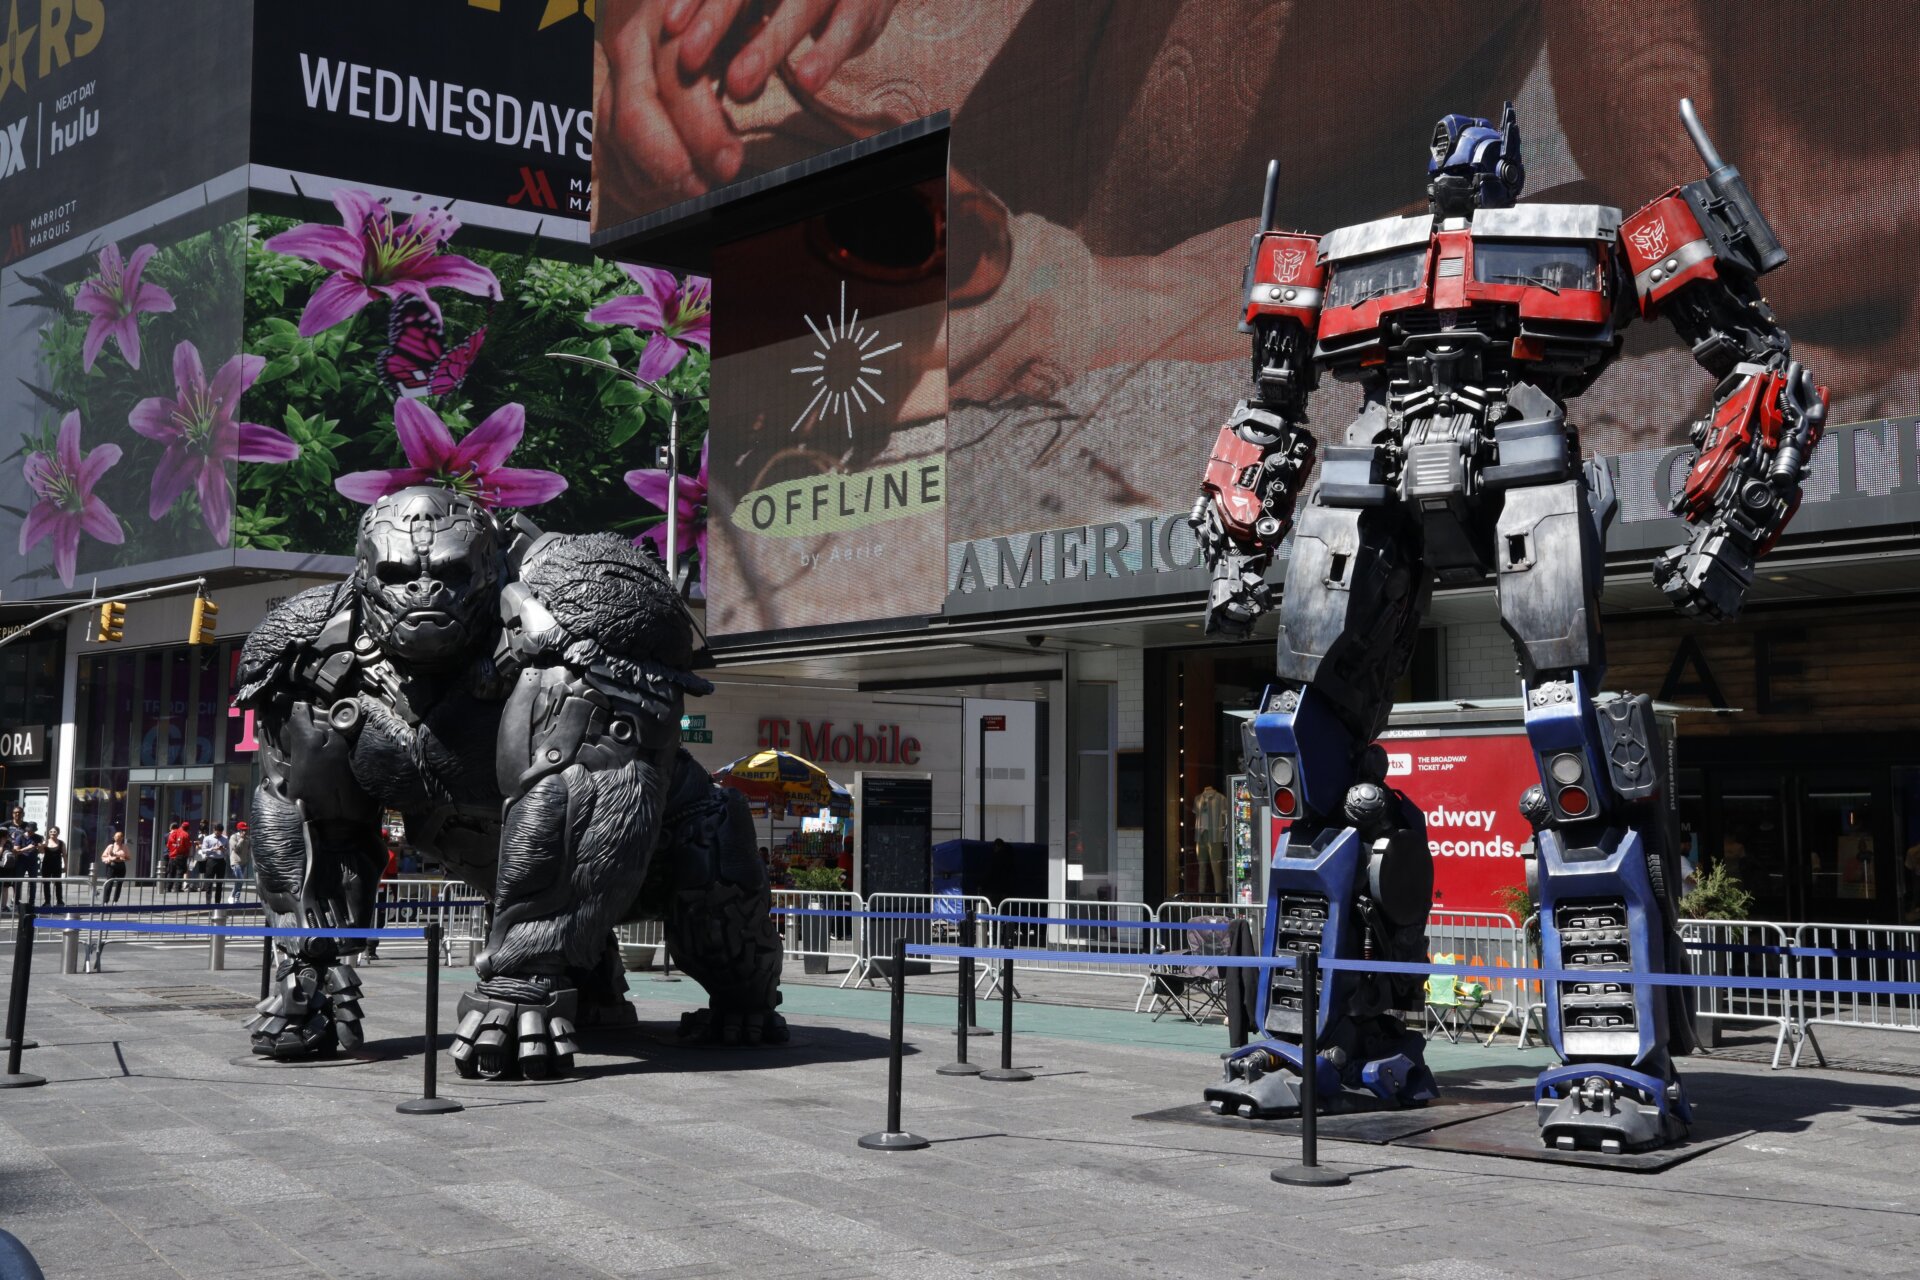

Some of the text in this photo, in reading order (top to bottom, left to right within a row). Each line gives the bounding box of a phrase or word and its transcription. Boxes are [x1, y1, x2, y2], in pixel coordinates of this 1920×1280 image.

[55, 80, 97, 114] NEXT DAY
[299, 52, 593, 161] WEDNESDAYS
[50, 107, 100, 155] hulu
[30, 200, 77, 231] MARRIOTT
[29, 222, 71, 248] MARQUIS
[751, 465, 941, 530] OFFLINE
[800, 542, 884, 569] by Aerie
[0, 732, 34, 756] ORA
[694, 731, 704, 742] 46
[797, 720, 922, 765] Mobile
[1387, 730, 1428, 738] JCDecaux
[1390, 759, 1405, 769] tix
[1418, 755, 1467, 764] THE BROADWAY
[1441, 763, 1454, 771] APP
[1424, 805, 1497, 831] dway
